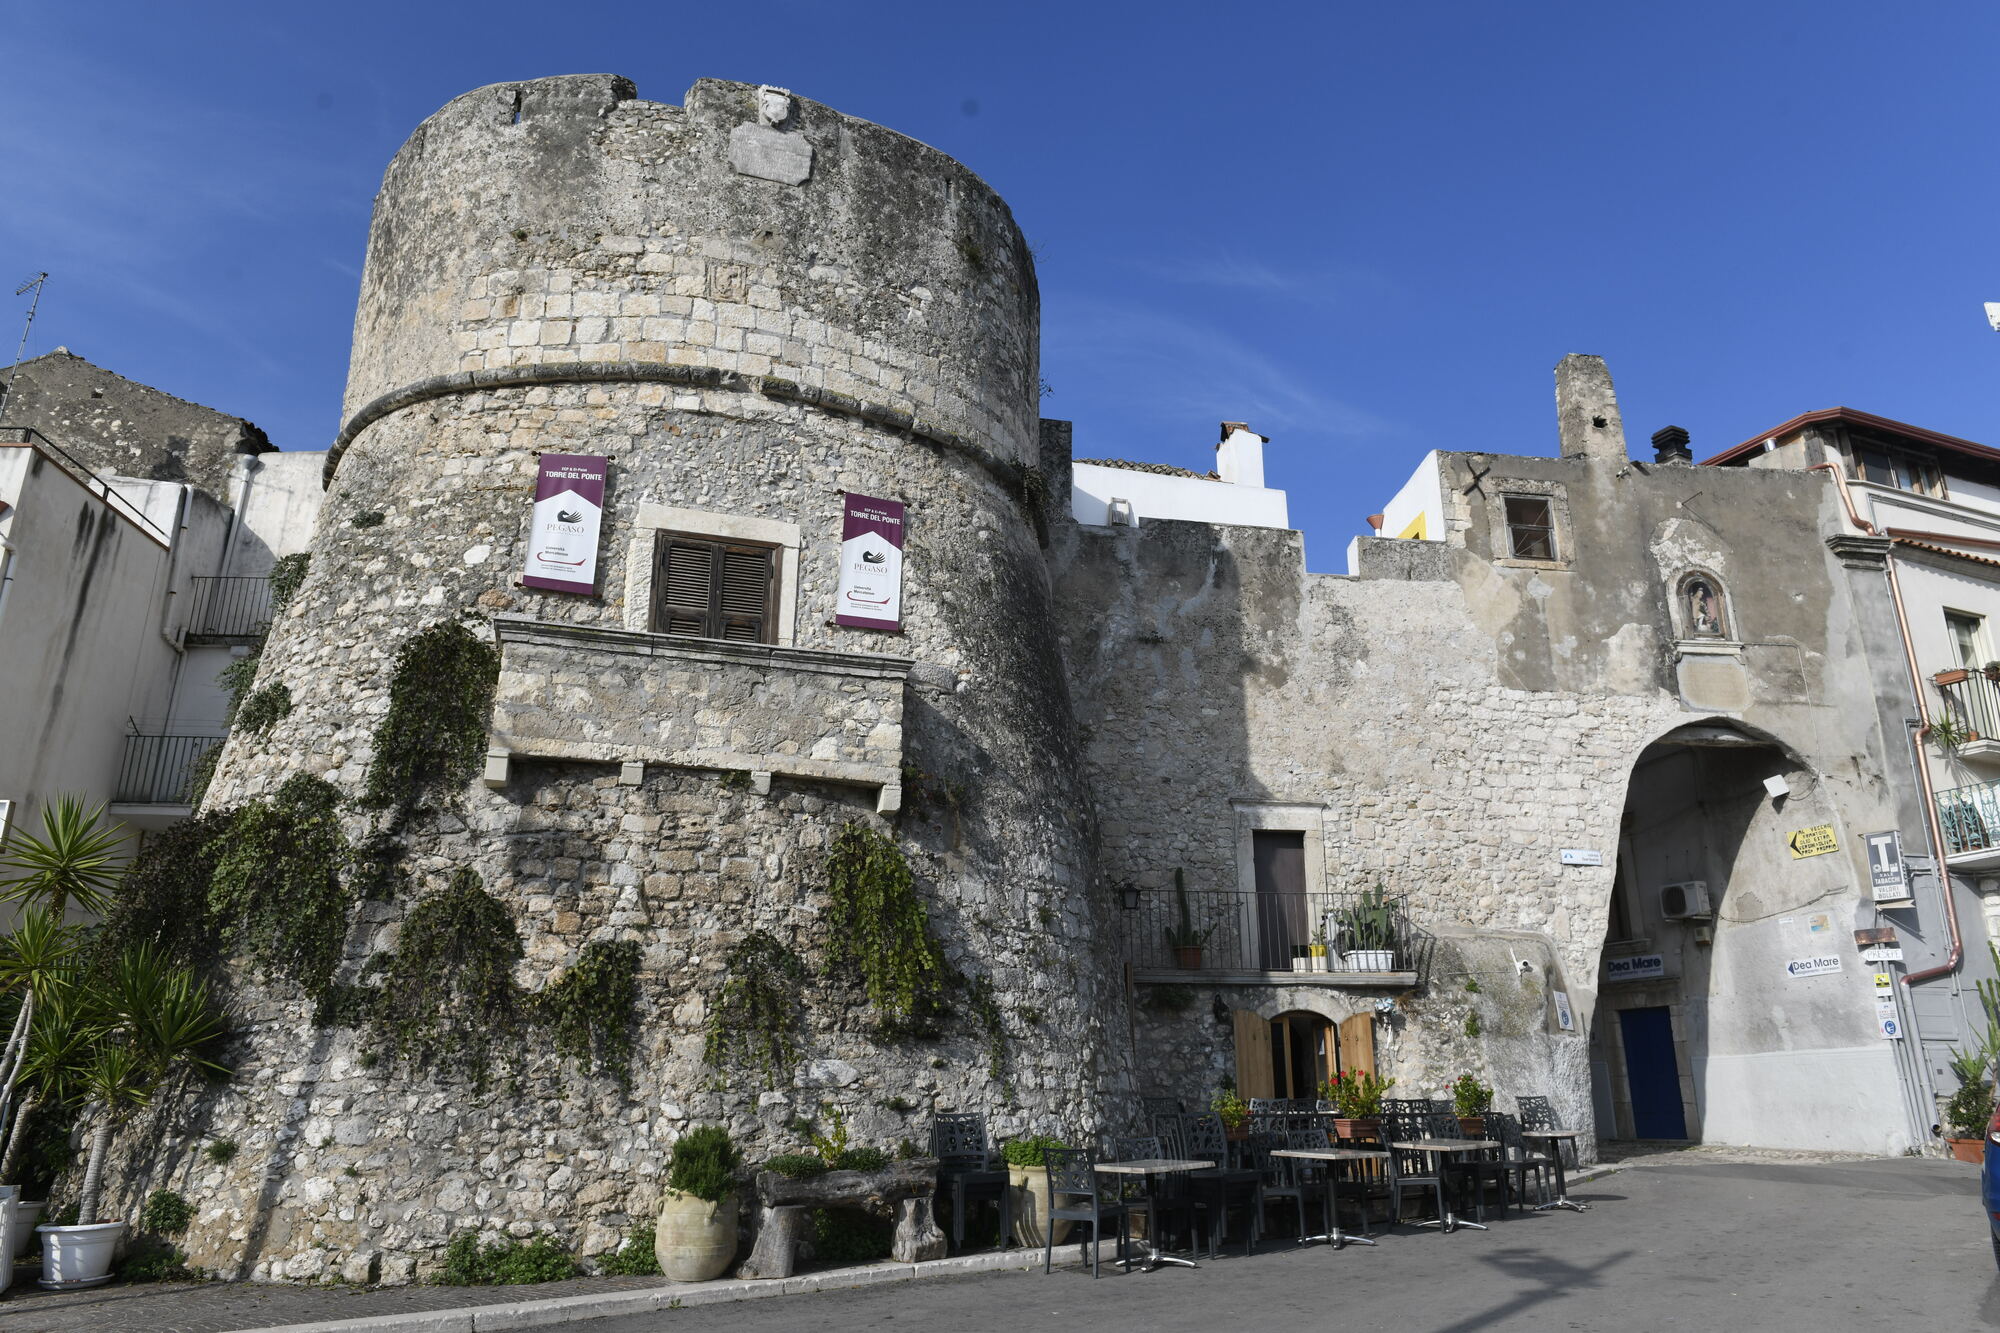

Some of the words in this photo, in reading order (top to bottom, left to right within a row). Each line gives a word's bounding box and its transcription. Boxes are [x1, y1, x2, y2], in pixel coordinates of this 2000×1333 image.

[546, 470, 567, 478] TORRE
[581, 473, 602, 481] PONTE
[850, 510, 869, 520] TORRE
[870, 514, 881, 522] DEL
[882, 516, 900, 525] PONTE
[546, 523, 584, 533] PEGASO
[854, 563, 888, 574] PEGASO
[1870, 836, 1892, 872] T
[1875, 876, 1901, 885] TABACCHI
[1878, 885, 1899, 893] VALORI
[1608, 962, 1630, 972] Dea
[1631, 958, 1662, 970] Mare
[1792, 961, 1812, 970] Dea
[1813, 958, 1839, 967] Mare
